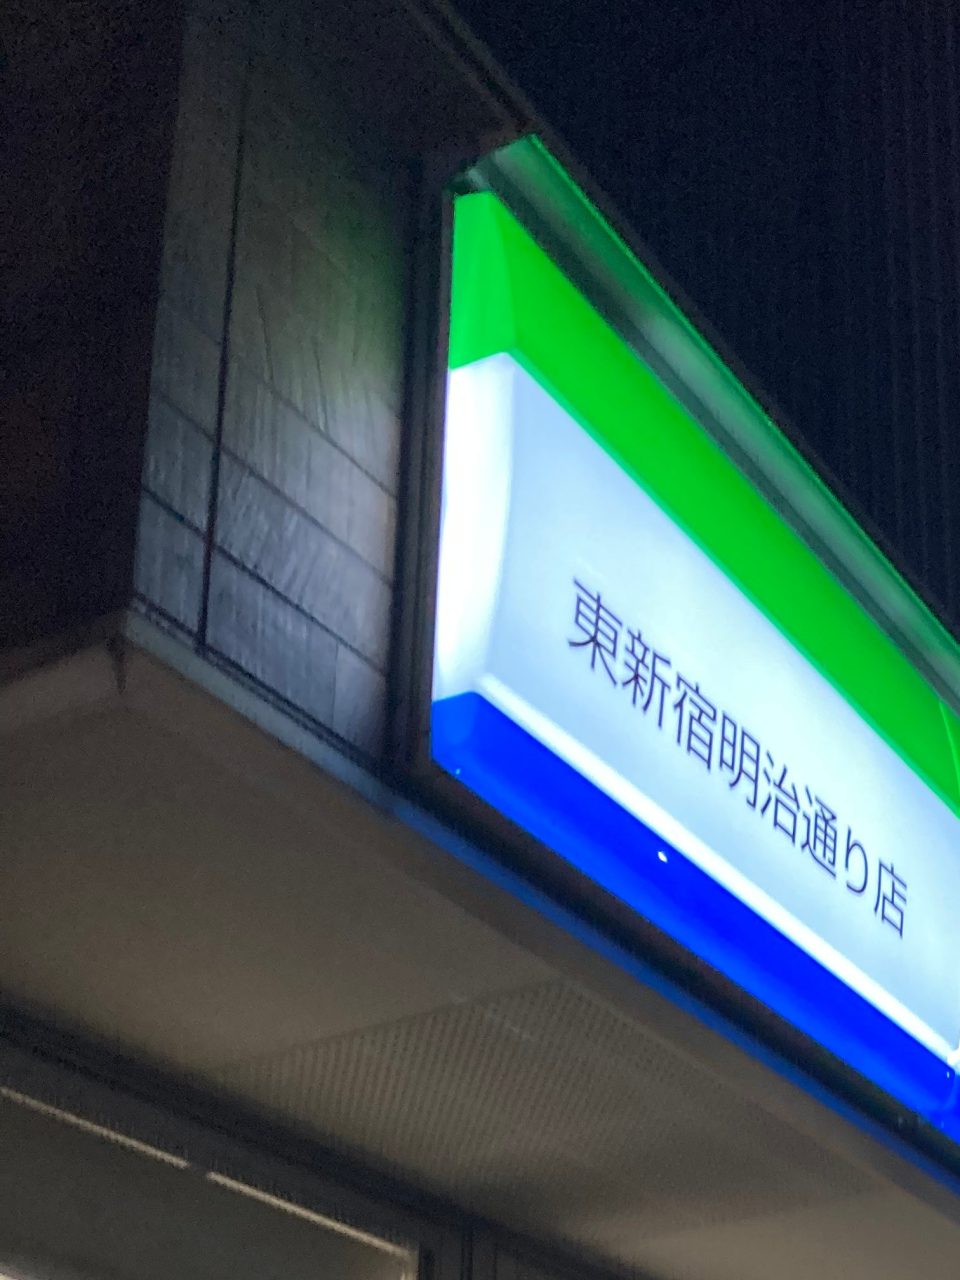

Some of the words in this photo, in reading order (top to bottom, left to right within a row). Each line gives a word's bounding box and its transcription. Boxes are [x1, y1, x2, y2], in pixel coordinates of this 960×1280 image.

[568, 577, 907, 940] 東新宿明治通り店
